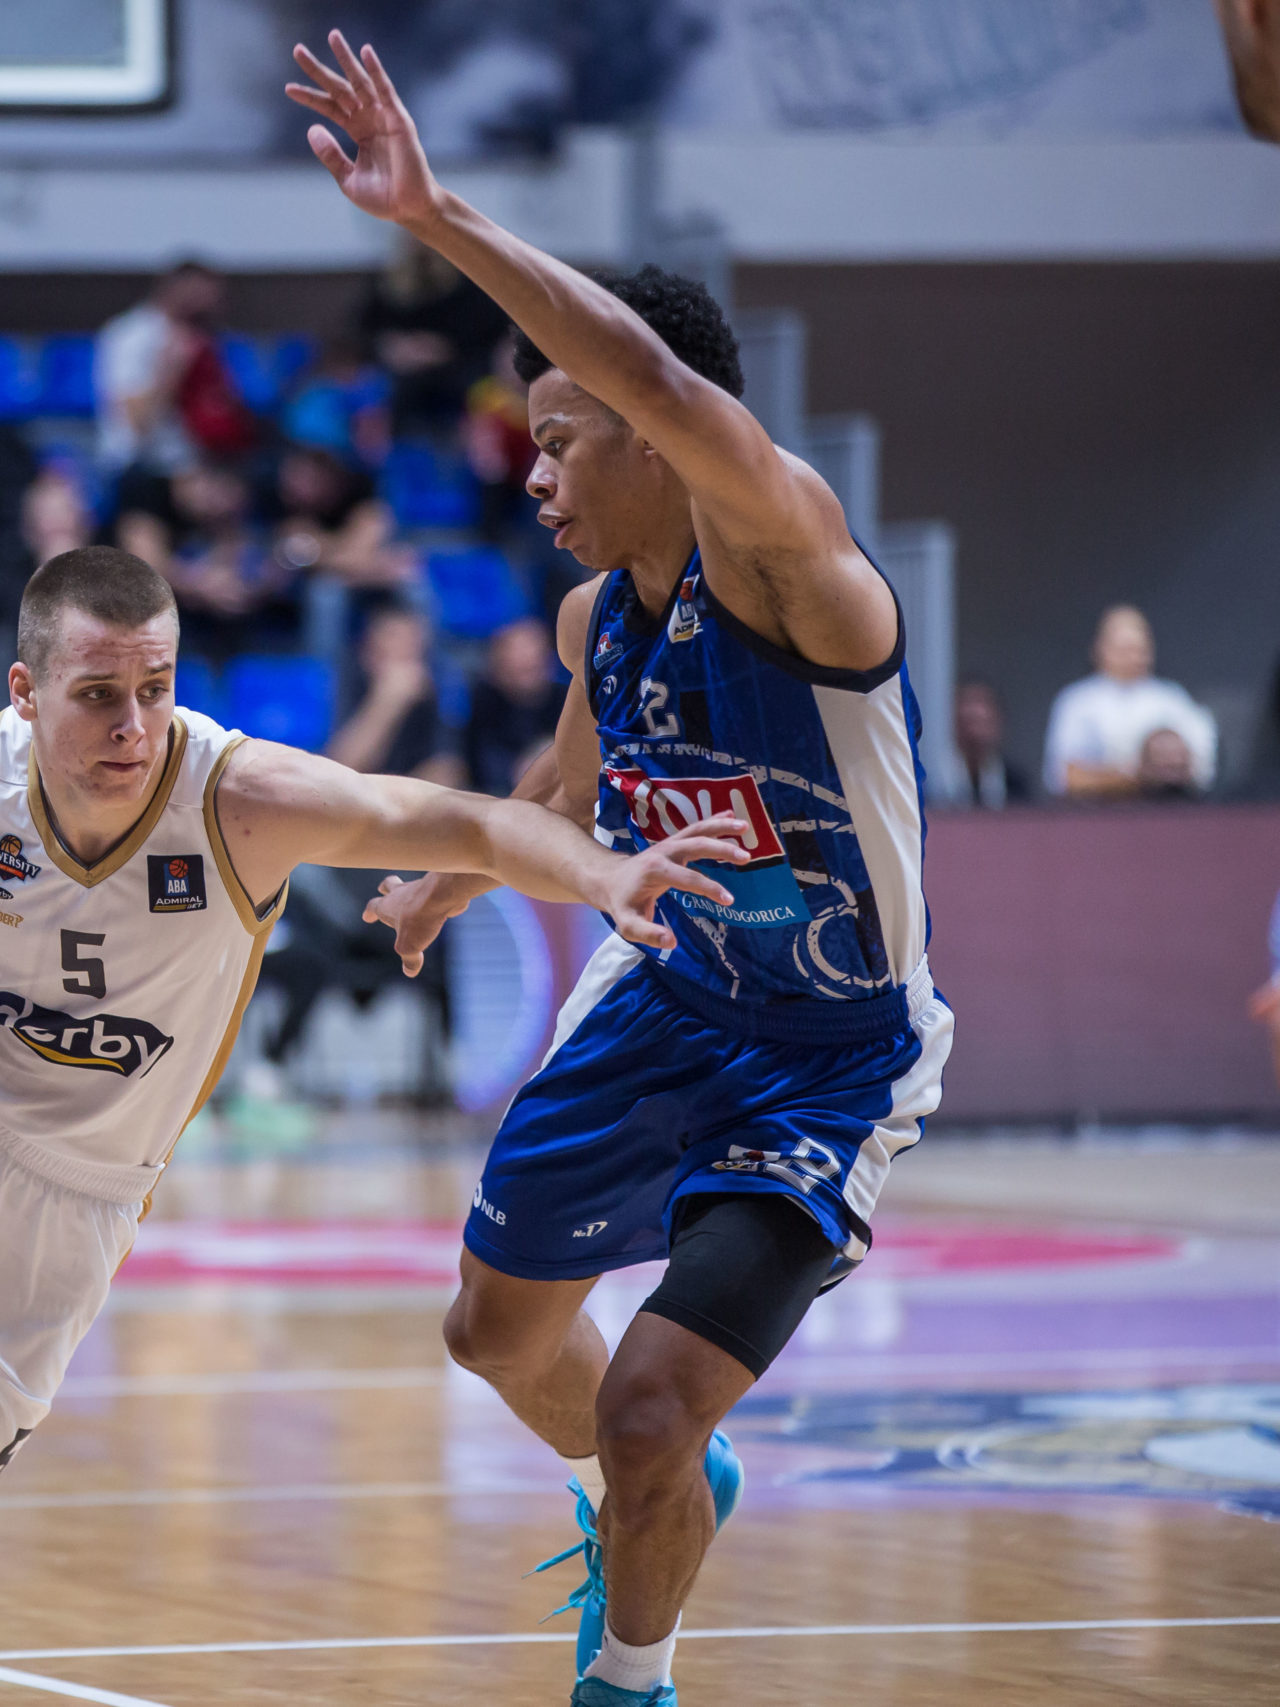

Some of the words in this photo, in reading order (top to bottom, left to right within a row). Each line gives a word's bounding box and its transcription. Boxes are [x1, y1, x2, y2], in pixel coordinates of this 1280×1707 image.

[640, 676, 680, 737] 2
[167, 879, 188, 894] ABA
[156, 895, 203, 905] ADMIRAL
[715, 904, 796, 923] PODGORICA
[60, 928, 106, 999] 5
[480, 1198, 506, 1226] NLB
